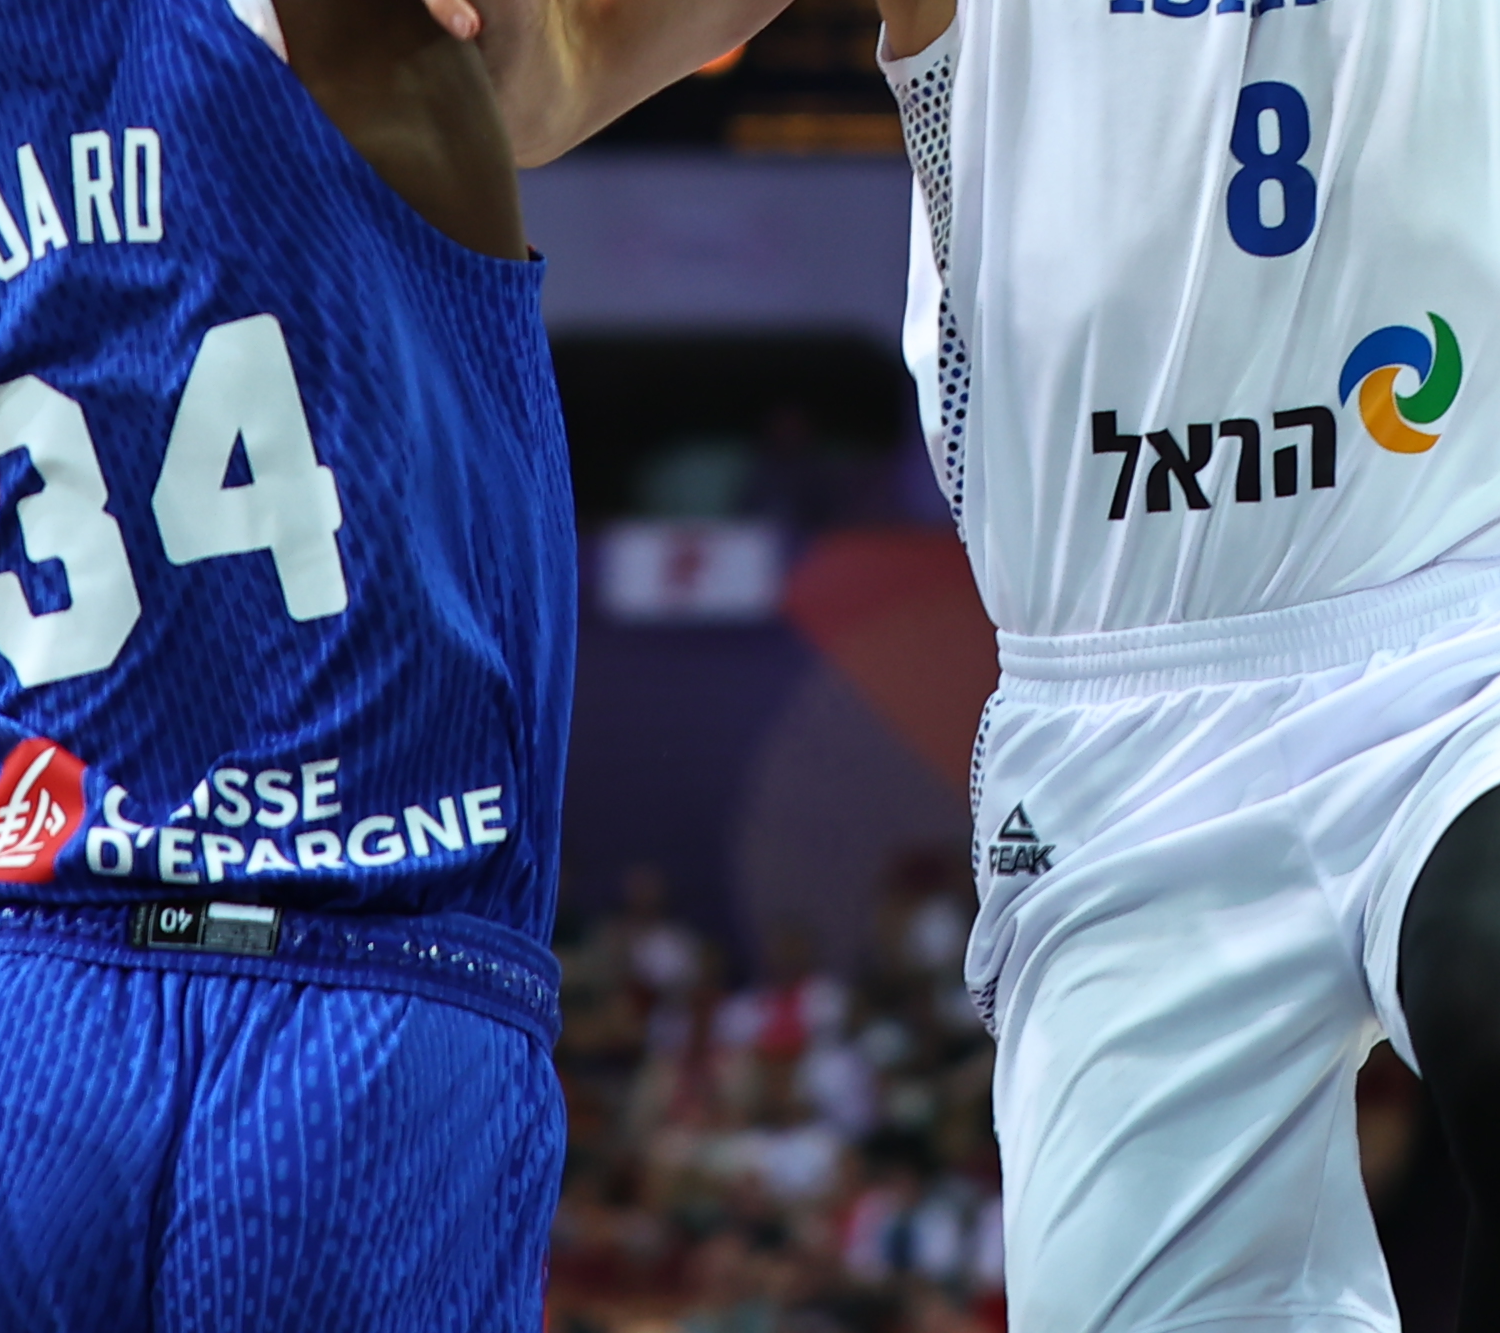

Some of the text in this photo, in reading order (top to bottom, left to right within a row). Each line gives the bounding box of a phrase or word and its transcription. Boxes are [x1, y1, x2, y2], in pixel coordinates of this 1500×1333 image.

[1226, 80, 1318, 258] 8
[1091, 404, 1338, 521] הראל
[86, 784, 508, 885] D'EPARGNE
[102, 757, 341, 833] CISSE
[988, 844, 1057, 877] PEAK
[159, 908, 194, 934] 40
